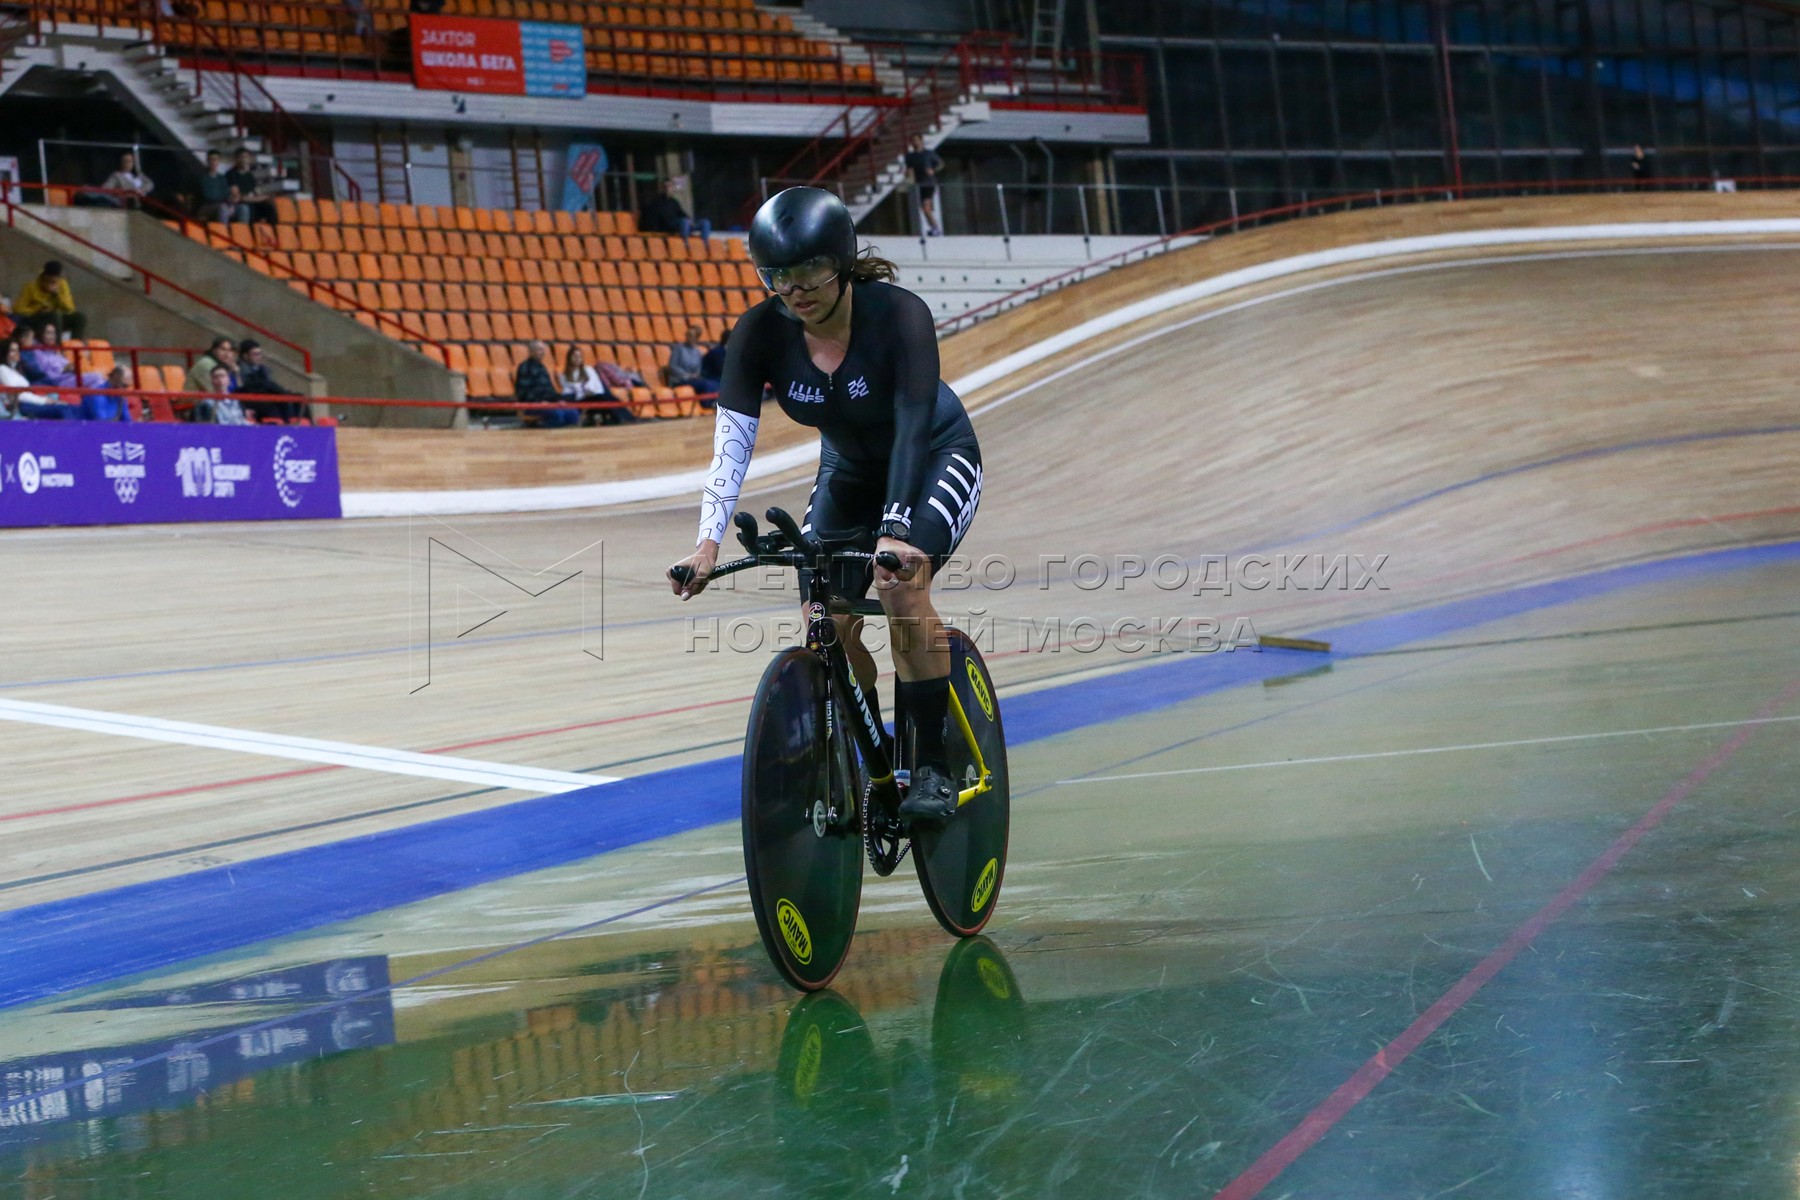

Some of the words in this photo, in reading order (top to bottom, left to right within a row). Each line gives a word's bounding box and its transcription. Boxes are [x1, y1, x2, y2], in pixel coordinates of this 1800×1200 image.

[421, 51, 477, 68] ШКОЛА
[481, 54, 516, 72] БЕГА
[713, 560, 742, 572] ASTON
[971, 667, 990, 711] MAVIC
[783, 908, 808, 954] MAVIC
